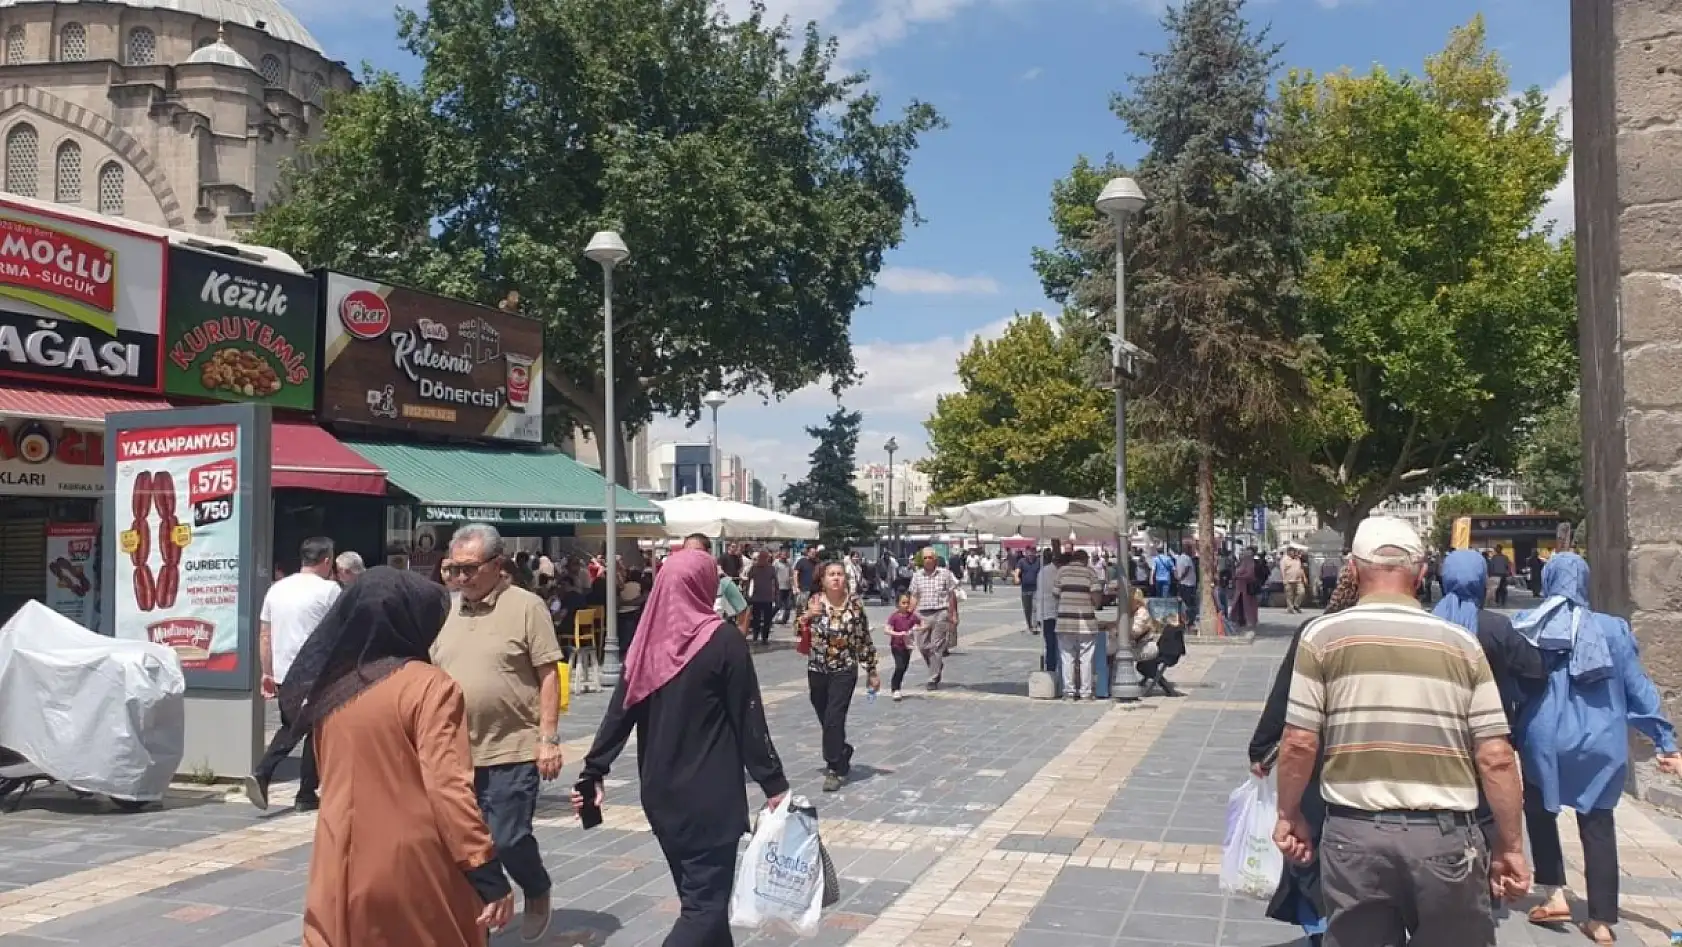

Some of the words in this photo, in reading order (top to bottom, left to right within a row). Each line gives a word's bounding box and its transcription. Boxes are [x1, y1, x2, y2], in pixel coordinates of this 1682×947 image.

[200, 270, 289, 316] Kezik
[121, 441, 145, 456] YAZ
[147, 431, 235, 454] KAMPANYASI
